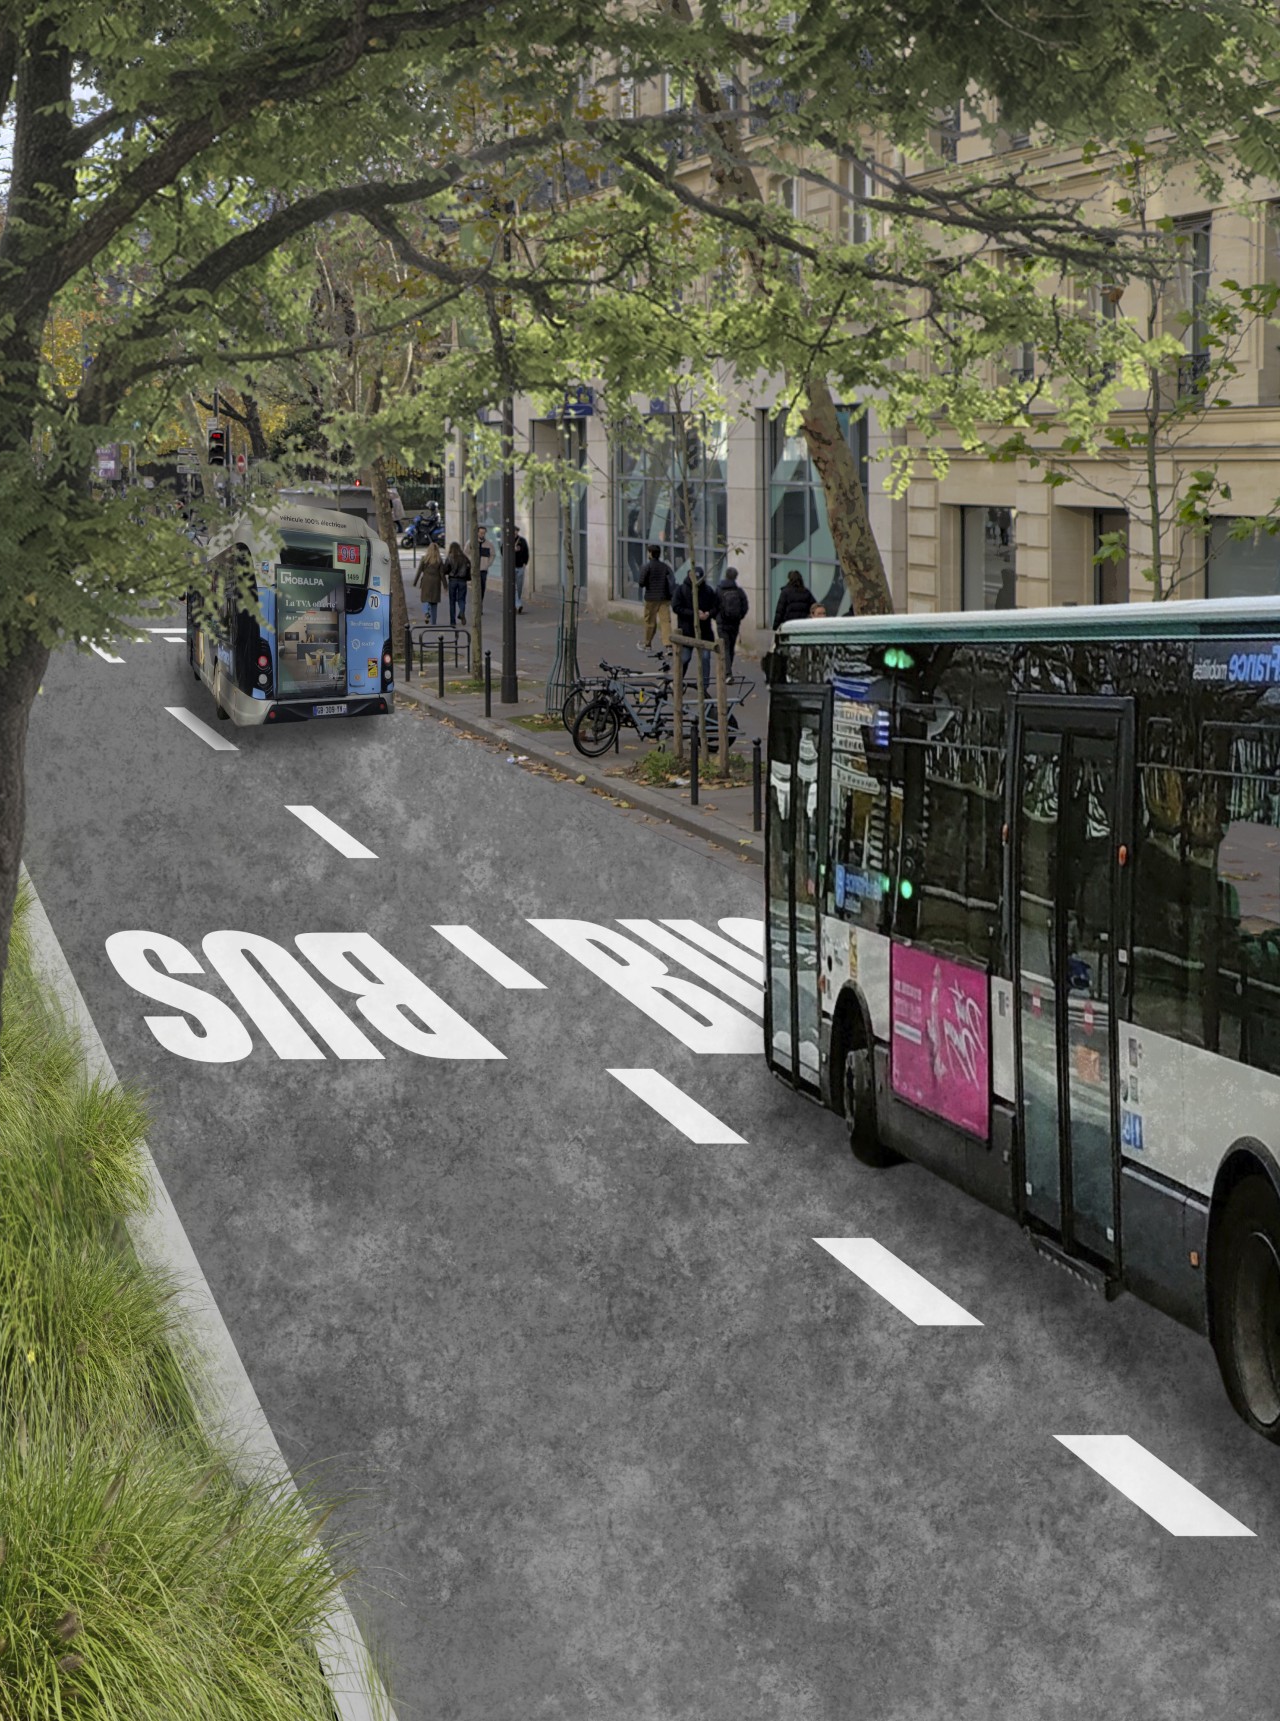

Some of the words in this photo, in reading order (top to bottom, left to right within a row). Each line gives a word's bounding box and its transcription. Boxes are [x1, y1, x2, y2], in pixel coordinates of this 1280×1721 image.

[279, 515, 304, 524] véhicule
[305, 518, 320, 526] 100%
[321, 520, 347, 529] électrique
[341, 547, 356, 561] 96
[285, 576, 324, 586] MOBALPA
[285, 599, 295, 607] La
[296, 600, 311, 608] TVA
[370, 595, 379, 608] 70
[105, 929, 509, 1063] BUS
